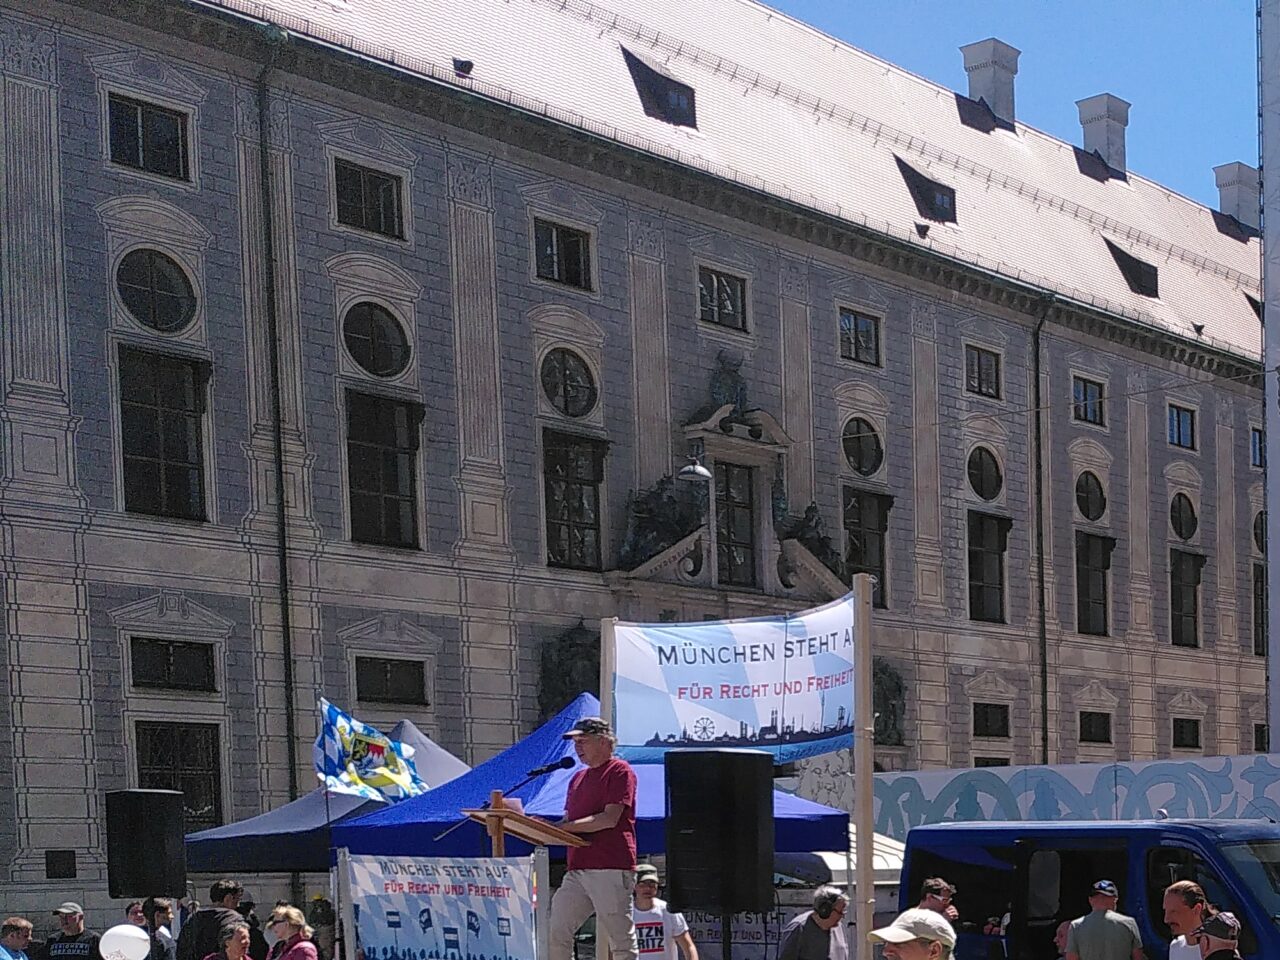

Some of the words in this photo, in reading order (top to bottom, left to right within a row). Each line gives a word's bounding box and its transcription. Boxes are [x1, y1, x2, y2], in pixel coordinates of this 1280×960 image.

[657, 641, 776, 666] MÜNCHEN
[784, 632, 838, 659] STEHT
[677, 683, 713, 700] FÜR
[720, 683, 769, 699] RECHT
[774, 680, 802, 696] UND
[808, 668, 854, 692] FREIHEIT
[381, 861, 440, 876] MÜNCHEN
[442, 866, 482, 878] STEHT
[486, 866, 508, 878] AUF
[384, 881, 404, 894] FÜR
[408, 881, 440, 894] RECHT
[444, 884, 464, 896] UND
[468, 884, 511, 898] FREIHEIT
